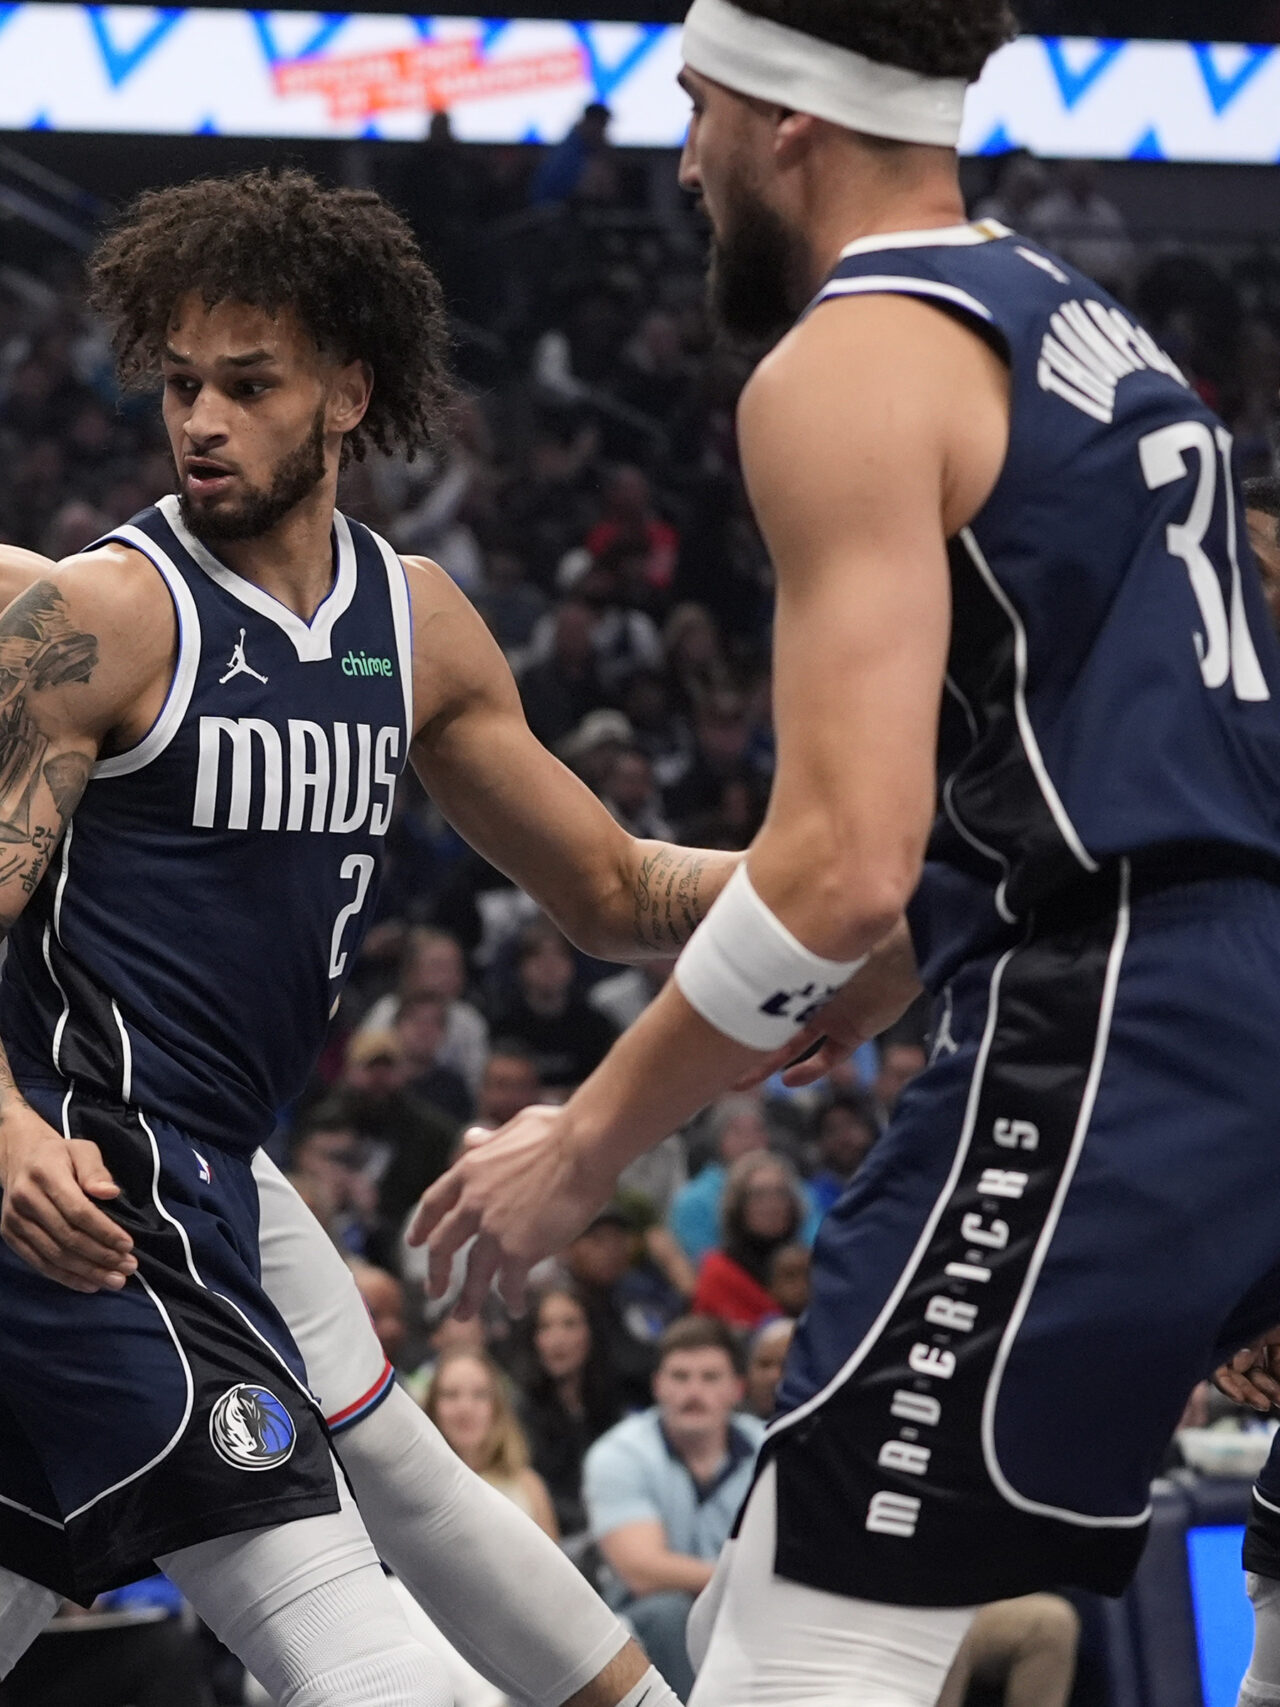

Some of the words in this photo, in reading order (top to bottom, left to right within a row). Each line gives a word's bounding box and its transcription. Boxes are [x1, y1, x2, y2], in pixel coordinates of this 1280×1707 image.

[1139, 421, 1270, 701] 31
[341, 650, 393, 678] chime
[192, 716, 400, 836] MAVS
[328, 853, 375, 980] 2
